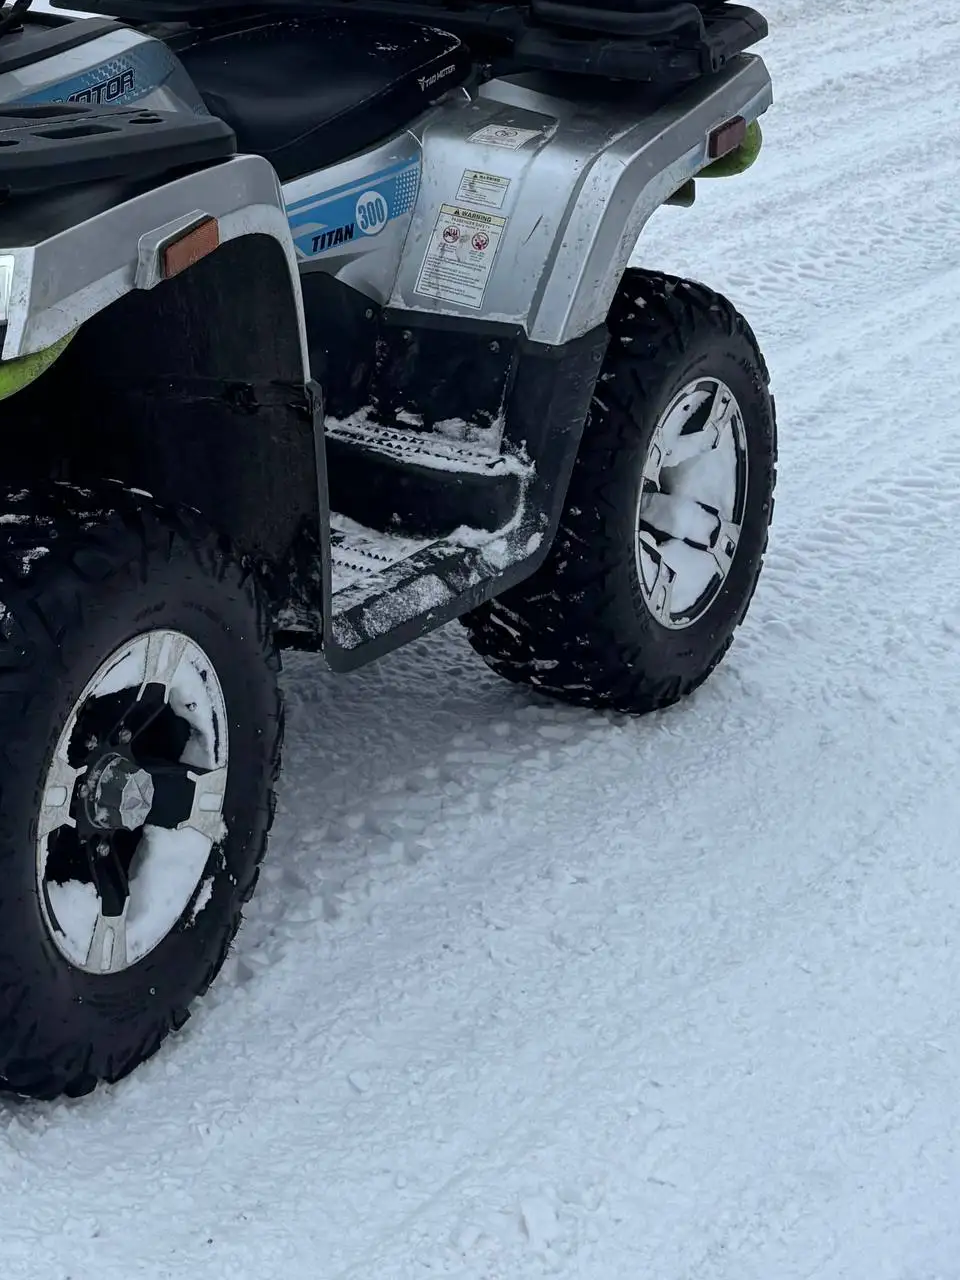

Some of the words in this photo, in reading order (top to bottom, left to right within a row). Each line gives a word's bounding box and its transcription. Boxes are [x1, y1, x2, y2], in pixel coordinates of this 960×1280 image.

[67, 67, 136, 104] OTOR
[311, 223, 355, 252] TITAN
[358, 199, 385, 230] 300
[461, 209, 492, 223] WARNING
